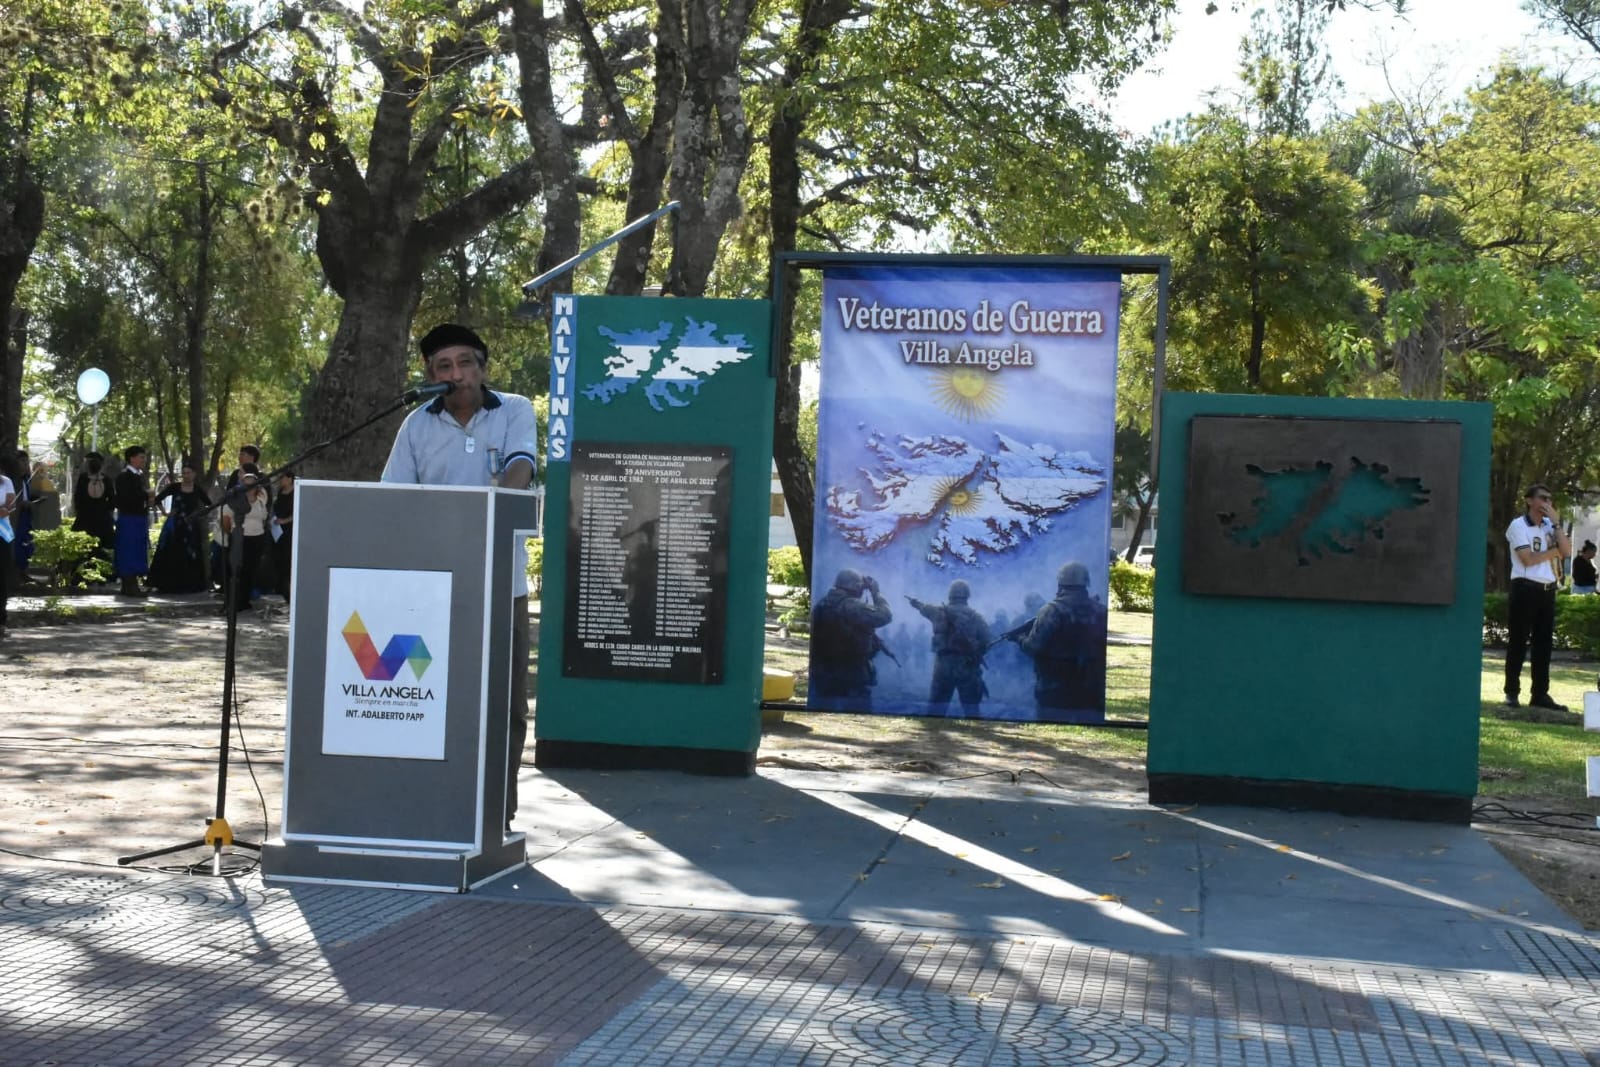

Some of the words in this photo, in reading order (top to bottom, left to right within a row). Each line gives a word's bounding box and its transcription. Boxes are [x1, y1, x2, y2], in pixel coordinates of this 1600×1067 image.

[838, 297, 966, 332] Veteranos
[972, 300, 1003, 332] de
[1009, 300, 1103, 334] Guerra
[900, 340, 950, 364] Villa
[955, 342, 1034, 370] Angela
[551, 297, 573, 459] MALVINAS
[342, 684, 376, 698] VILLA
[380, 686, 434, 700] ANGELA
[354, 698, 381, 706] Siempre
[346, 710, 359, 718] INT.
[362, 710, 405, 720] ADALBERTO
[406, 712, 424, 721] PAPP
